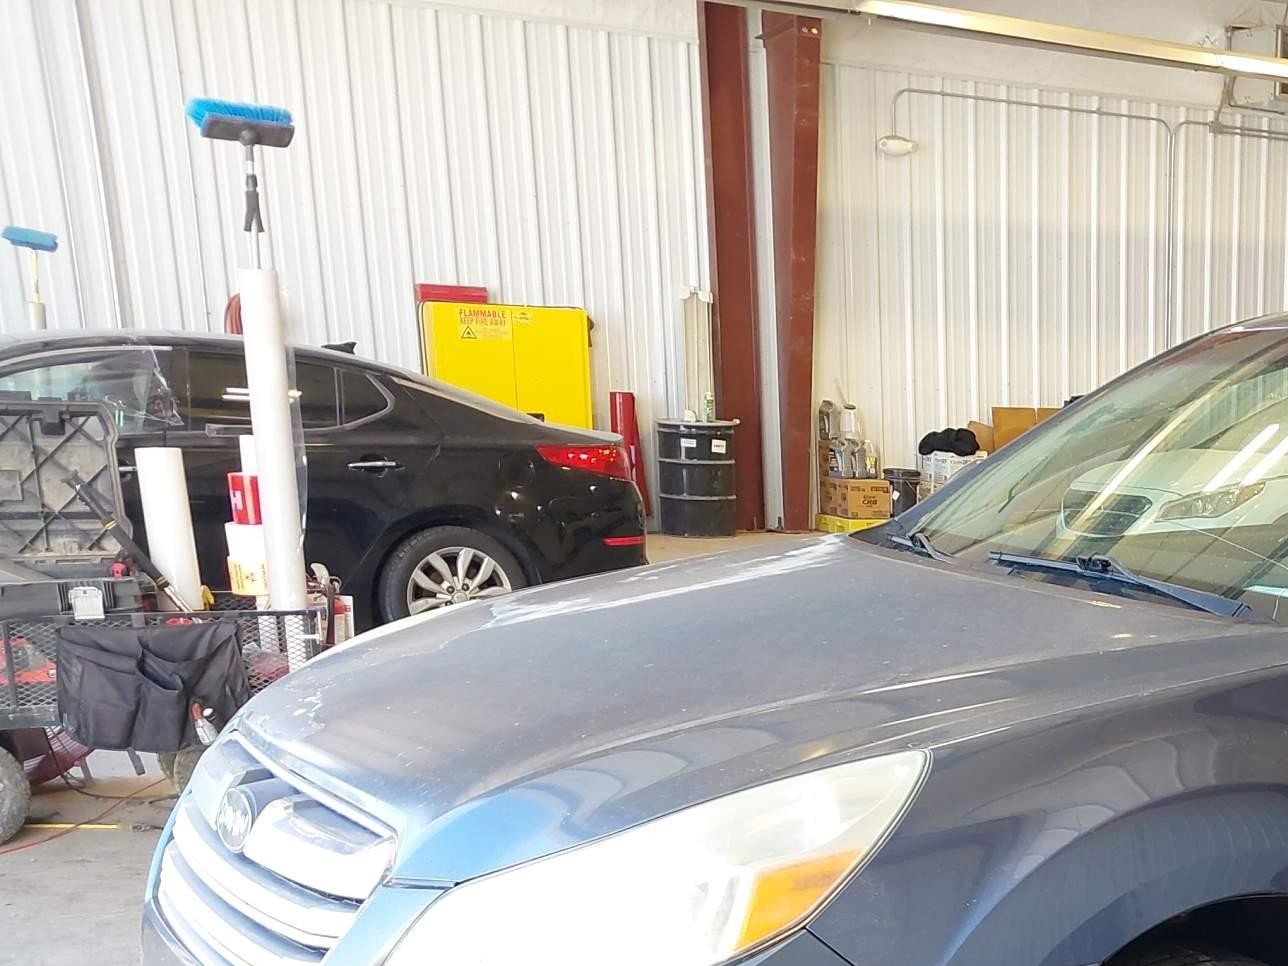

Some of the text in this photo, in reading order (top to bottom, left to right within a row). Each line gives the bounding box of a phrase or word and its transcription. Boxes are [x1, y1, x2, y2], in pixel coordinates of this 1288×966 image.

[459, 308, 507, 319] FLAMMABLE
[460, 317, 474, 325] KEEP
[475, 318, 488, 326] FIRE
[490, 318, 506, 326] AWAY
